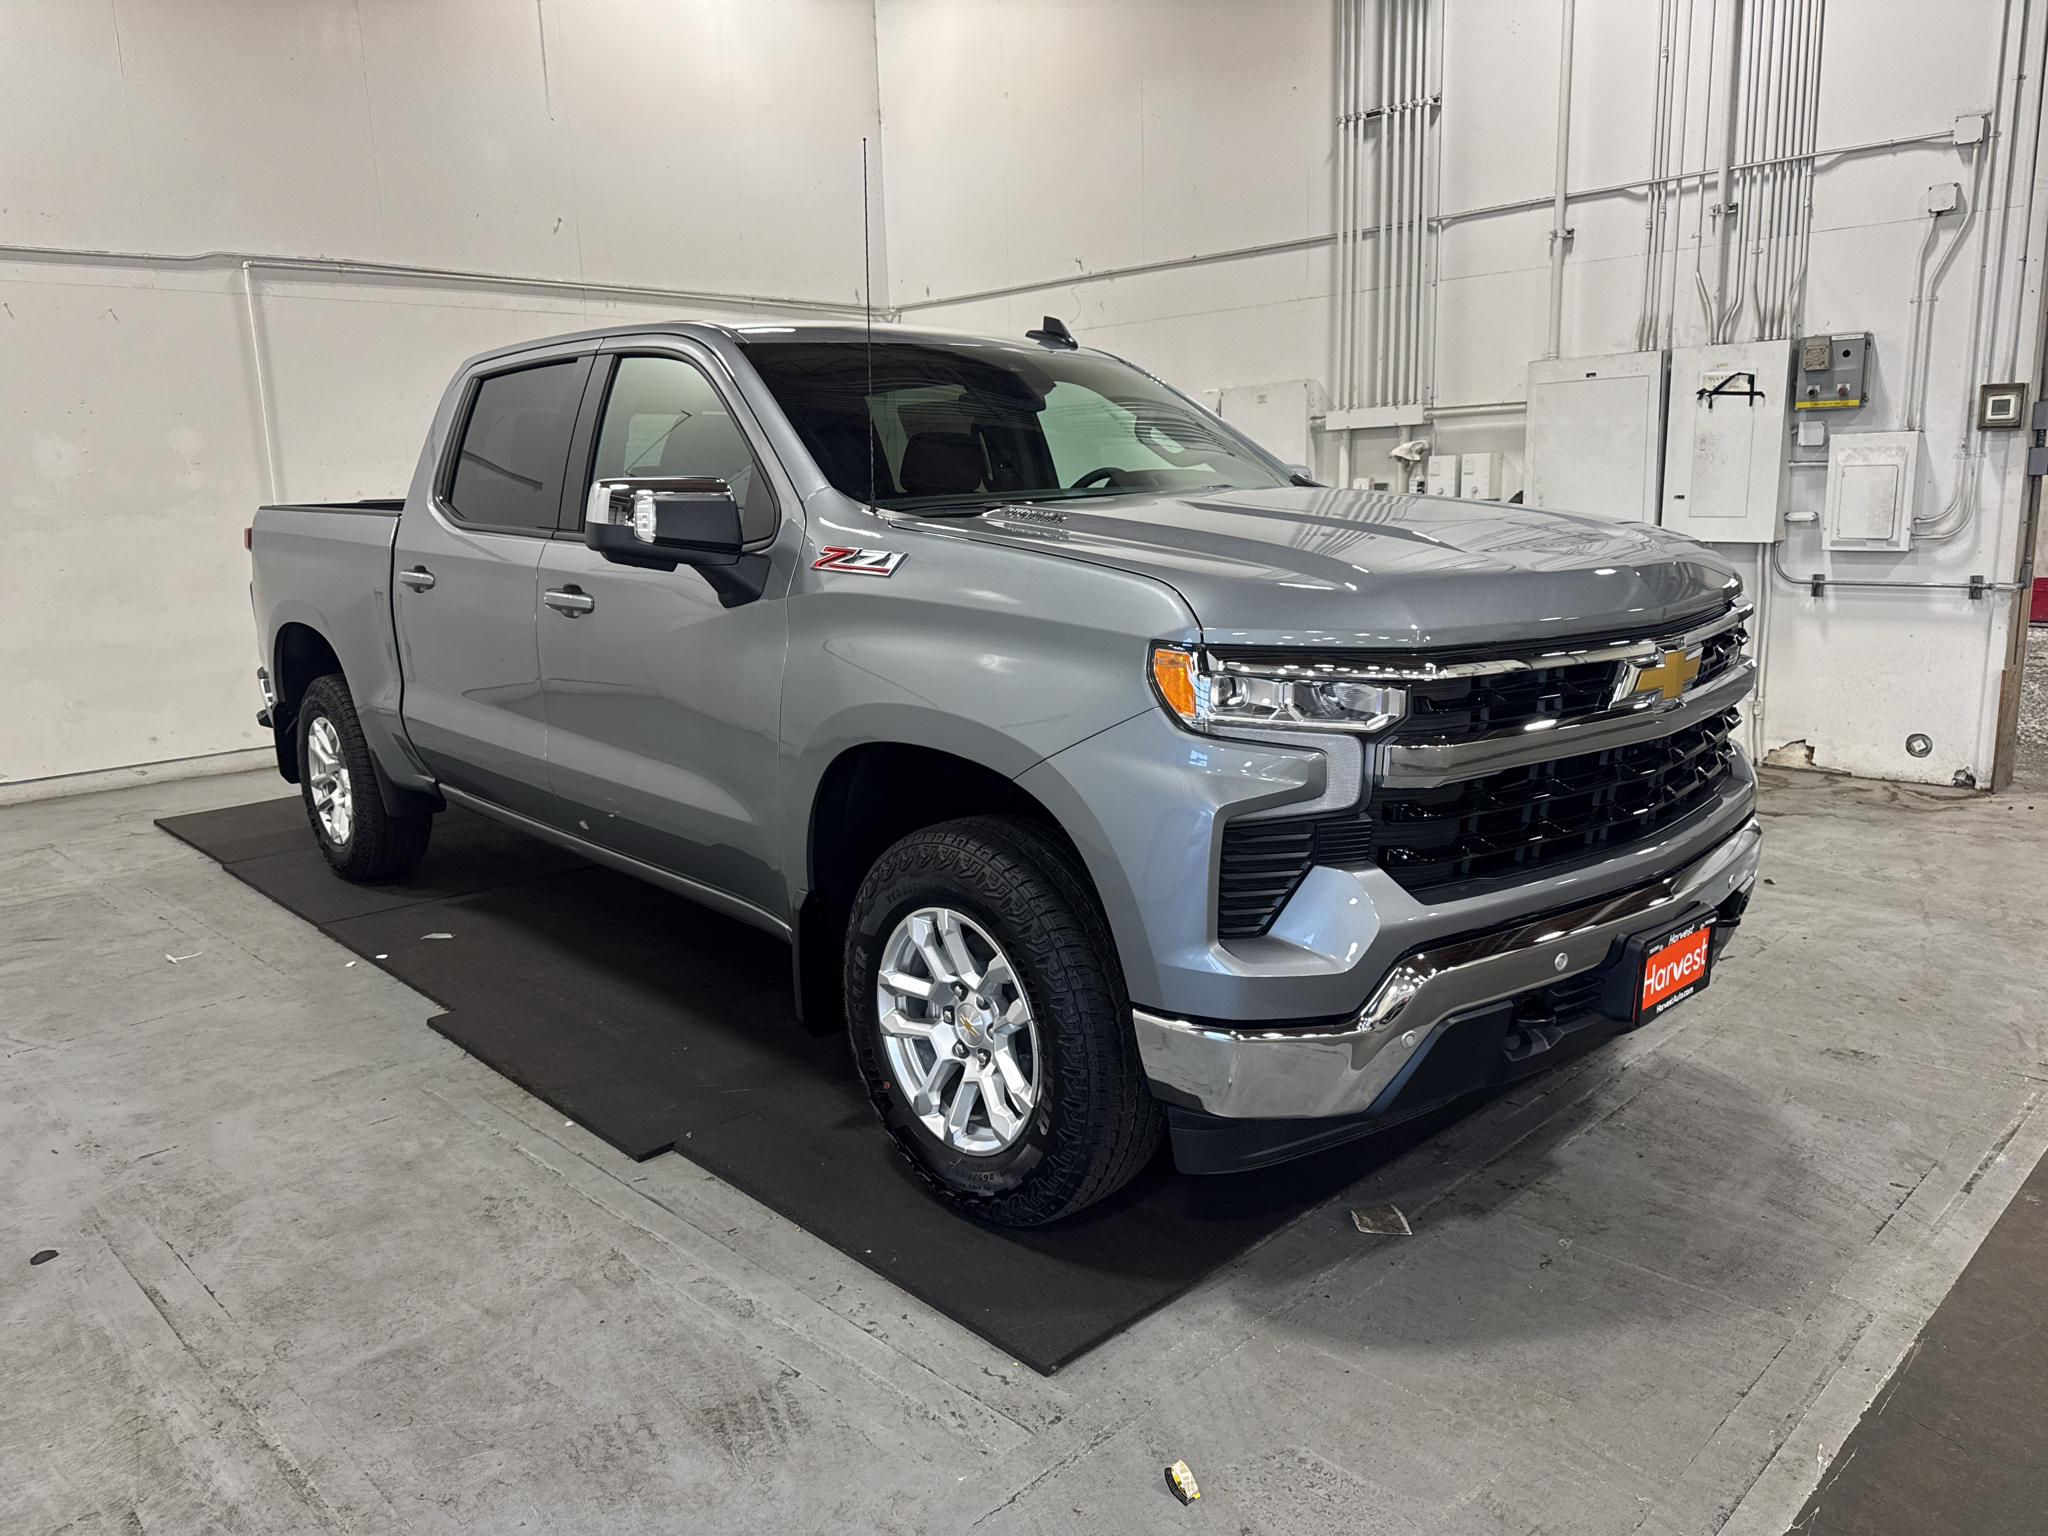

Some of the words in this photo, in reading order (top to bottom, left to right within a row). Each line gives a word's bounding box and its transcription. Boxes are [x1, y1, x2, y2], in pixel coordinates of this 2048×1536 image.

[810, 545, 908, 577] Z71
[1668, 923, 1695, 946] Harvest
[1643, 937, 1708, 998] Harvest
[1656, 987, 1694, 1013] HarvestAuto.com
[851, 945, 895, 1116] WRANGLER
